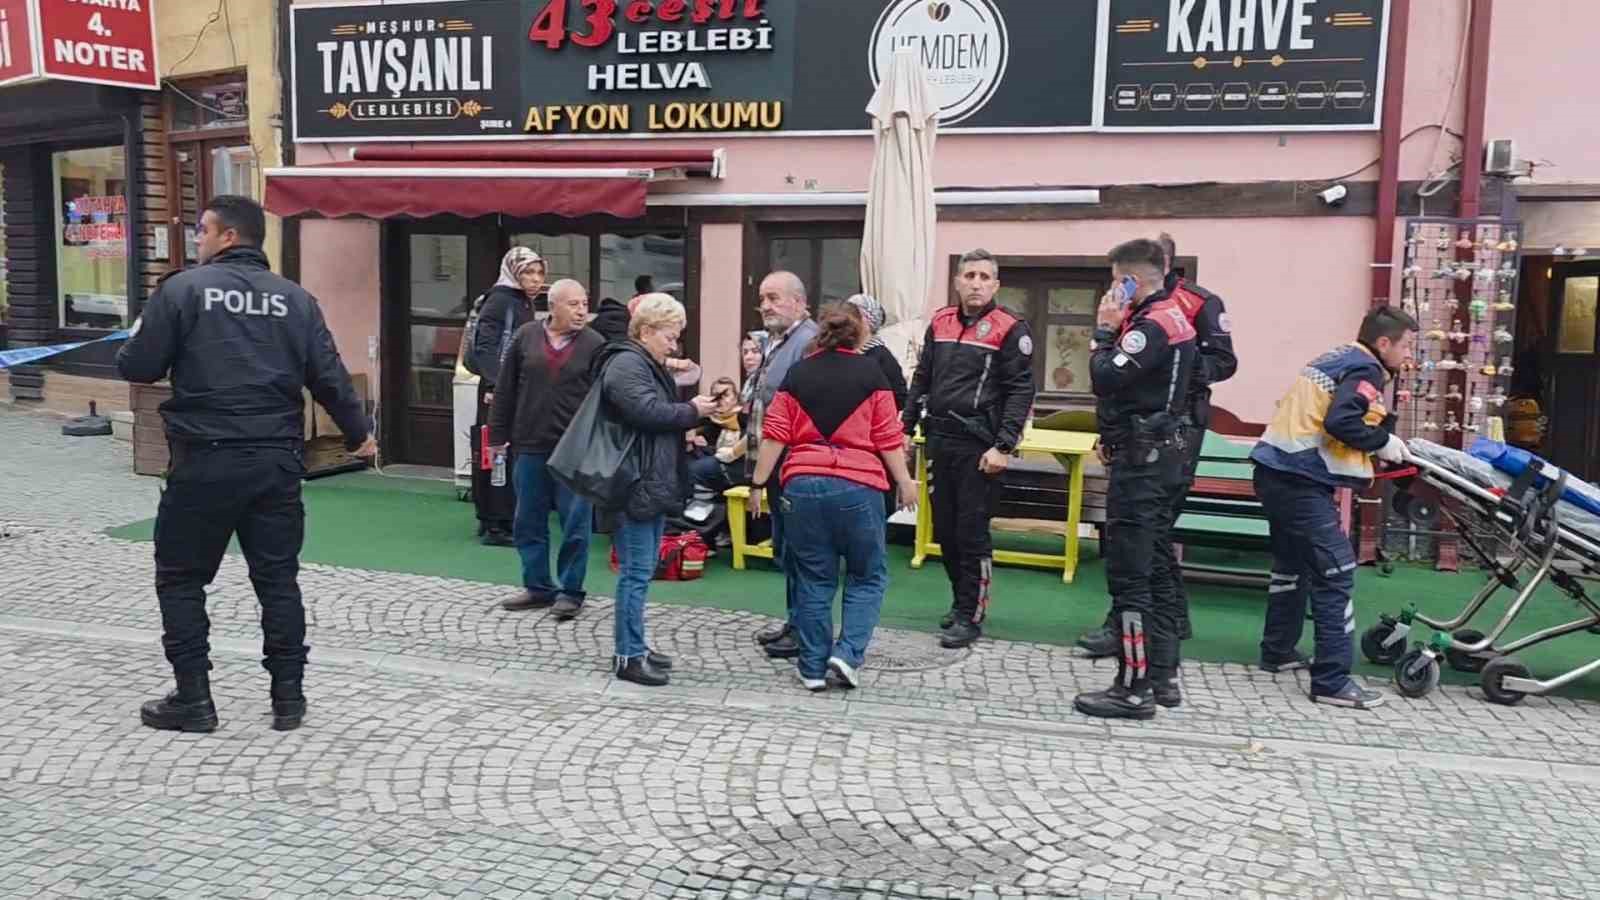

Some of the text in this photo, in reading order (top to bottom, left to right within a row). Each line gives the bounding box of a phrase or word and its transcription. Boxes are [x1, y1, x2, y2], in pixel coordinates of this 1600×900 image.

[87, 12, 112, 36] 4.
[366, 19, 437, 35] MEŞHUR
[528, 0, 616, 49] 43
[617, 19, 773, 53] LEBLEBİ
[1166, 0, 1317, 52] KAHVE
[53, 38, 147, 72] NOTER
[317, 36, 493, 98] TAVŞANLI
[588, 62, 710, 90] HELVA
[357, 101, 453, 117] LEBLEBİSİ
[524, 101, 783, 131] AFYON LOKUMU
